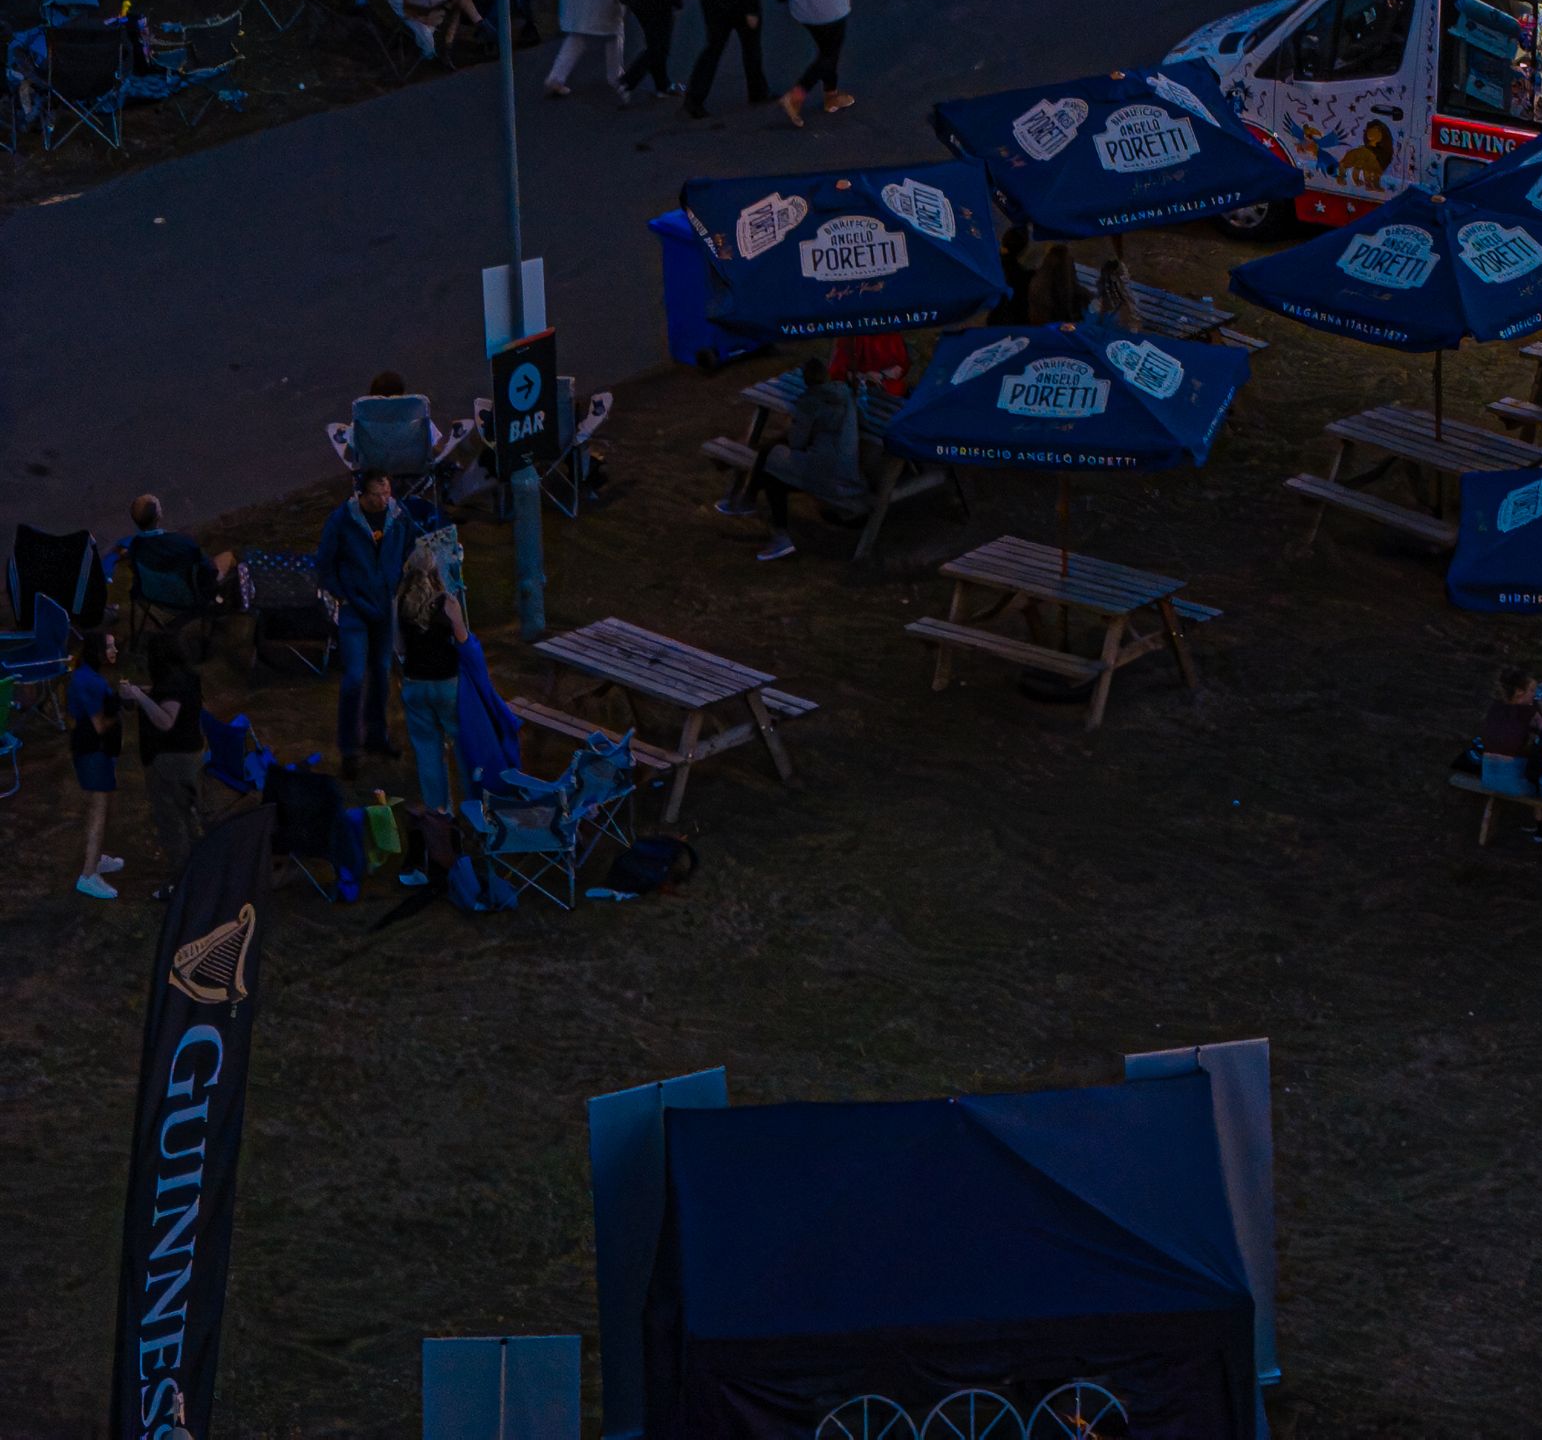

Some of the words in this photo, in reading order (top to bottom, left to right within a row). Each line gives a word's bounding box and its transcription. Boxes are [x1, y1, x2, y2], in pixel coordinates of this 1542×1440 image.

[1120, 120, 1160, 136] ANGELO
[1106, 130, 1188, 163] PORETTI
[1438, 127, 1517, 155] SERVING
[1099, 208, 1164, 227] VALGANNA
[1167, 200, 1206, 214] ITALIA
[831, 230, 873, 244] ANGELO
[812, 240, 896, 271] PORETTI
[1350, 244, 1428, 283] PORETTI
[1470, 237, 1539, 277] PORETTI
[781, 320, 853, 335] VALGANNA
[858, 313, 900, 329] ITALIA
[1282, 302, 1342, 327] VALGANNA
[1033, 360, 1087, 375] BIRRIFICIO
[1036, 373, 1080, 386] ANGELO
[1010, 385, 1097, 408] PORETTI
[508, 411, 545, 443] BAR
[936, 445, 1012, 461] BIRRIFICIO
[1017, 451, 1073, 464] ANGELO
[1079, 454, 1137, 468] PORETTI
